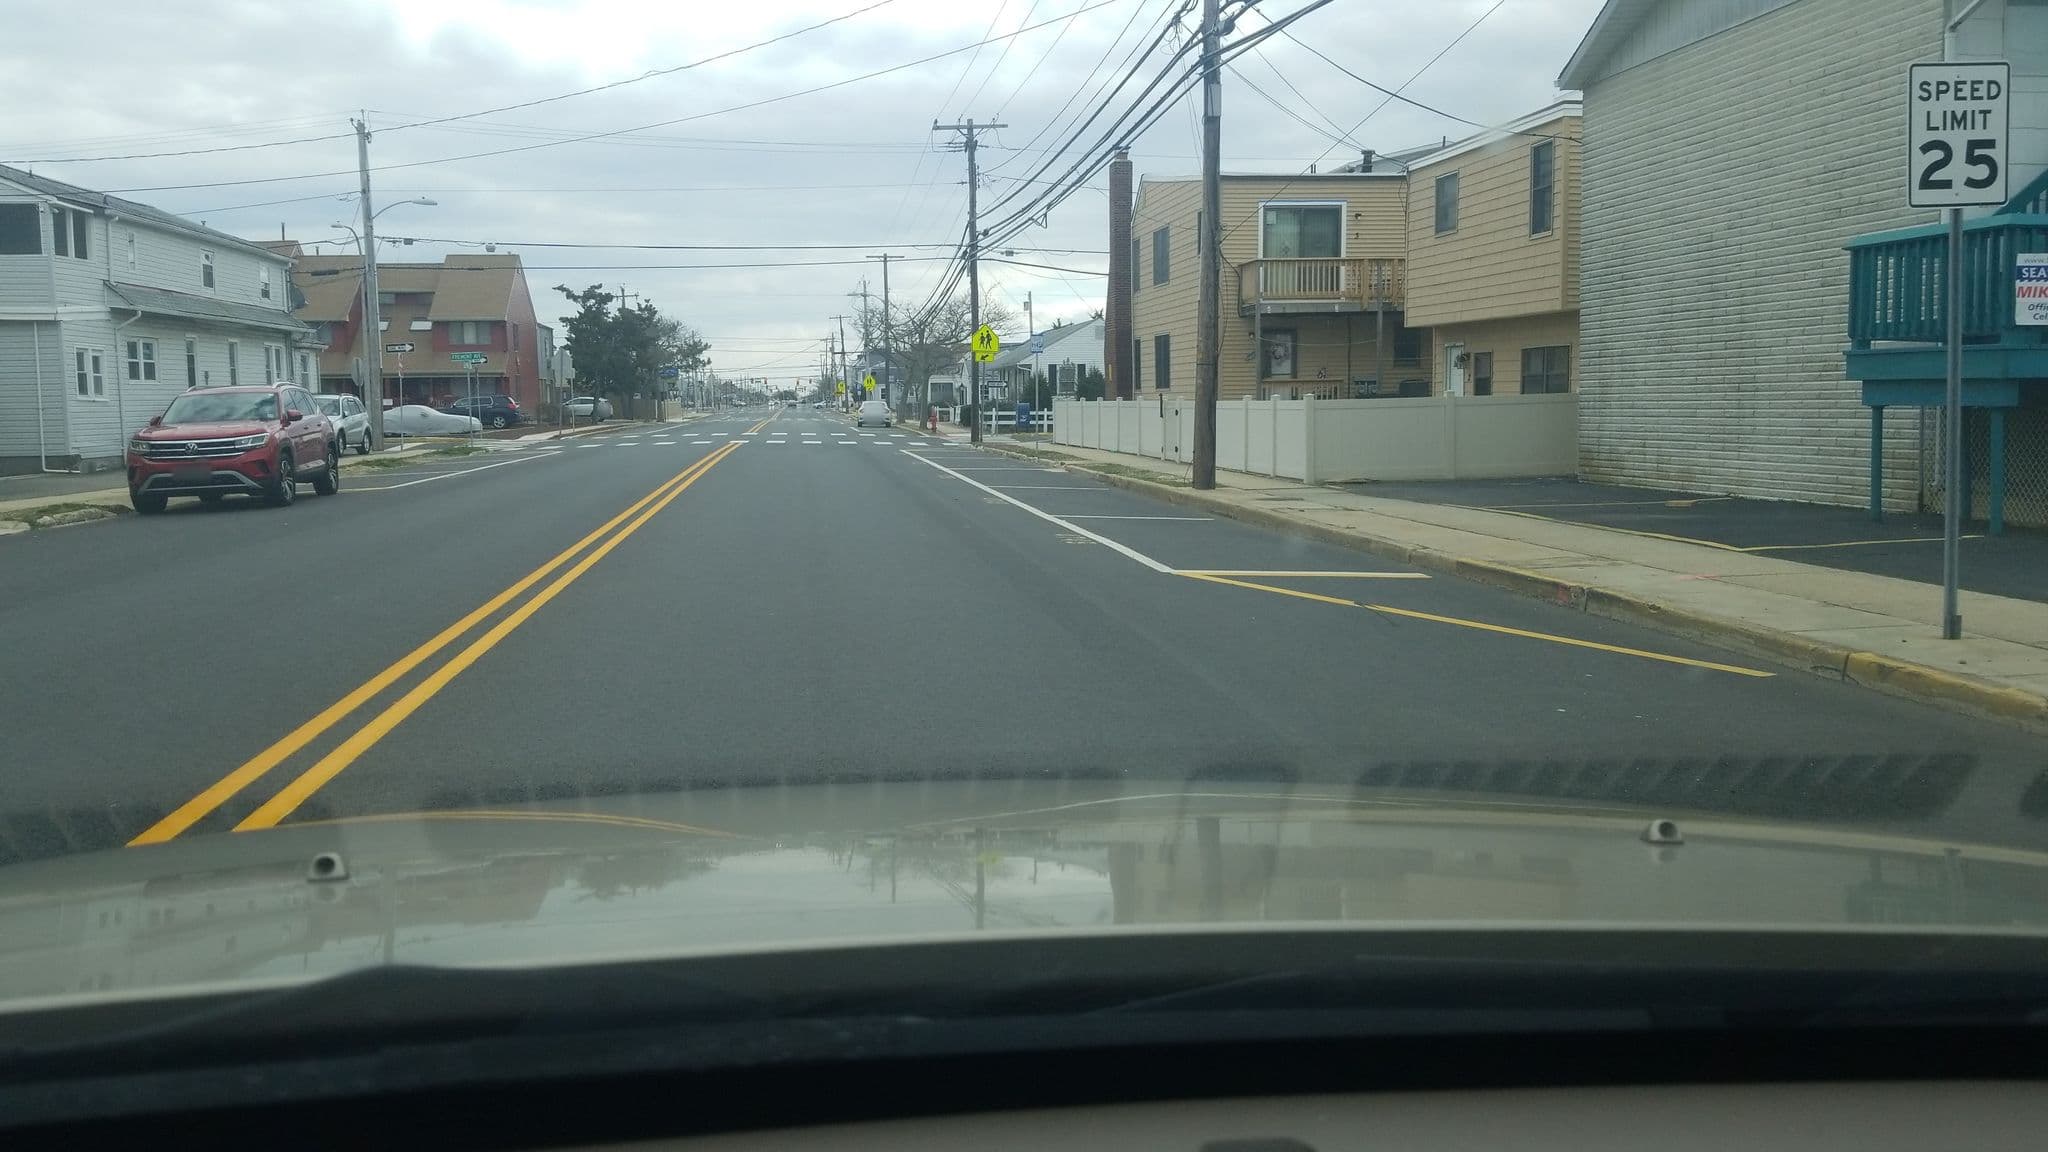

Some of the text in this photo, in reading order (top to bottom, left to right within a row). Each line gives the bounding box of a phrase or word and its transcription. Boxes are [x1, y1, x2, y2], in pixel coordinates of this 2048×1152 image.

[1918, 80, 2001, 102] SPEED
[1926, 109, 1992, 131] LIMIT
[1918, 139, 1998, 190] 25
[2022, 267, 2047, 278] SEA
[2016, 286, 2048, 298] MIK
